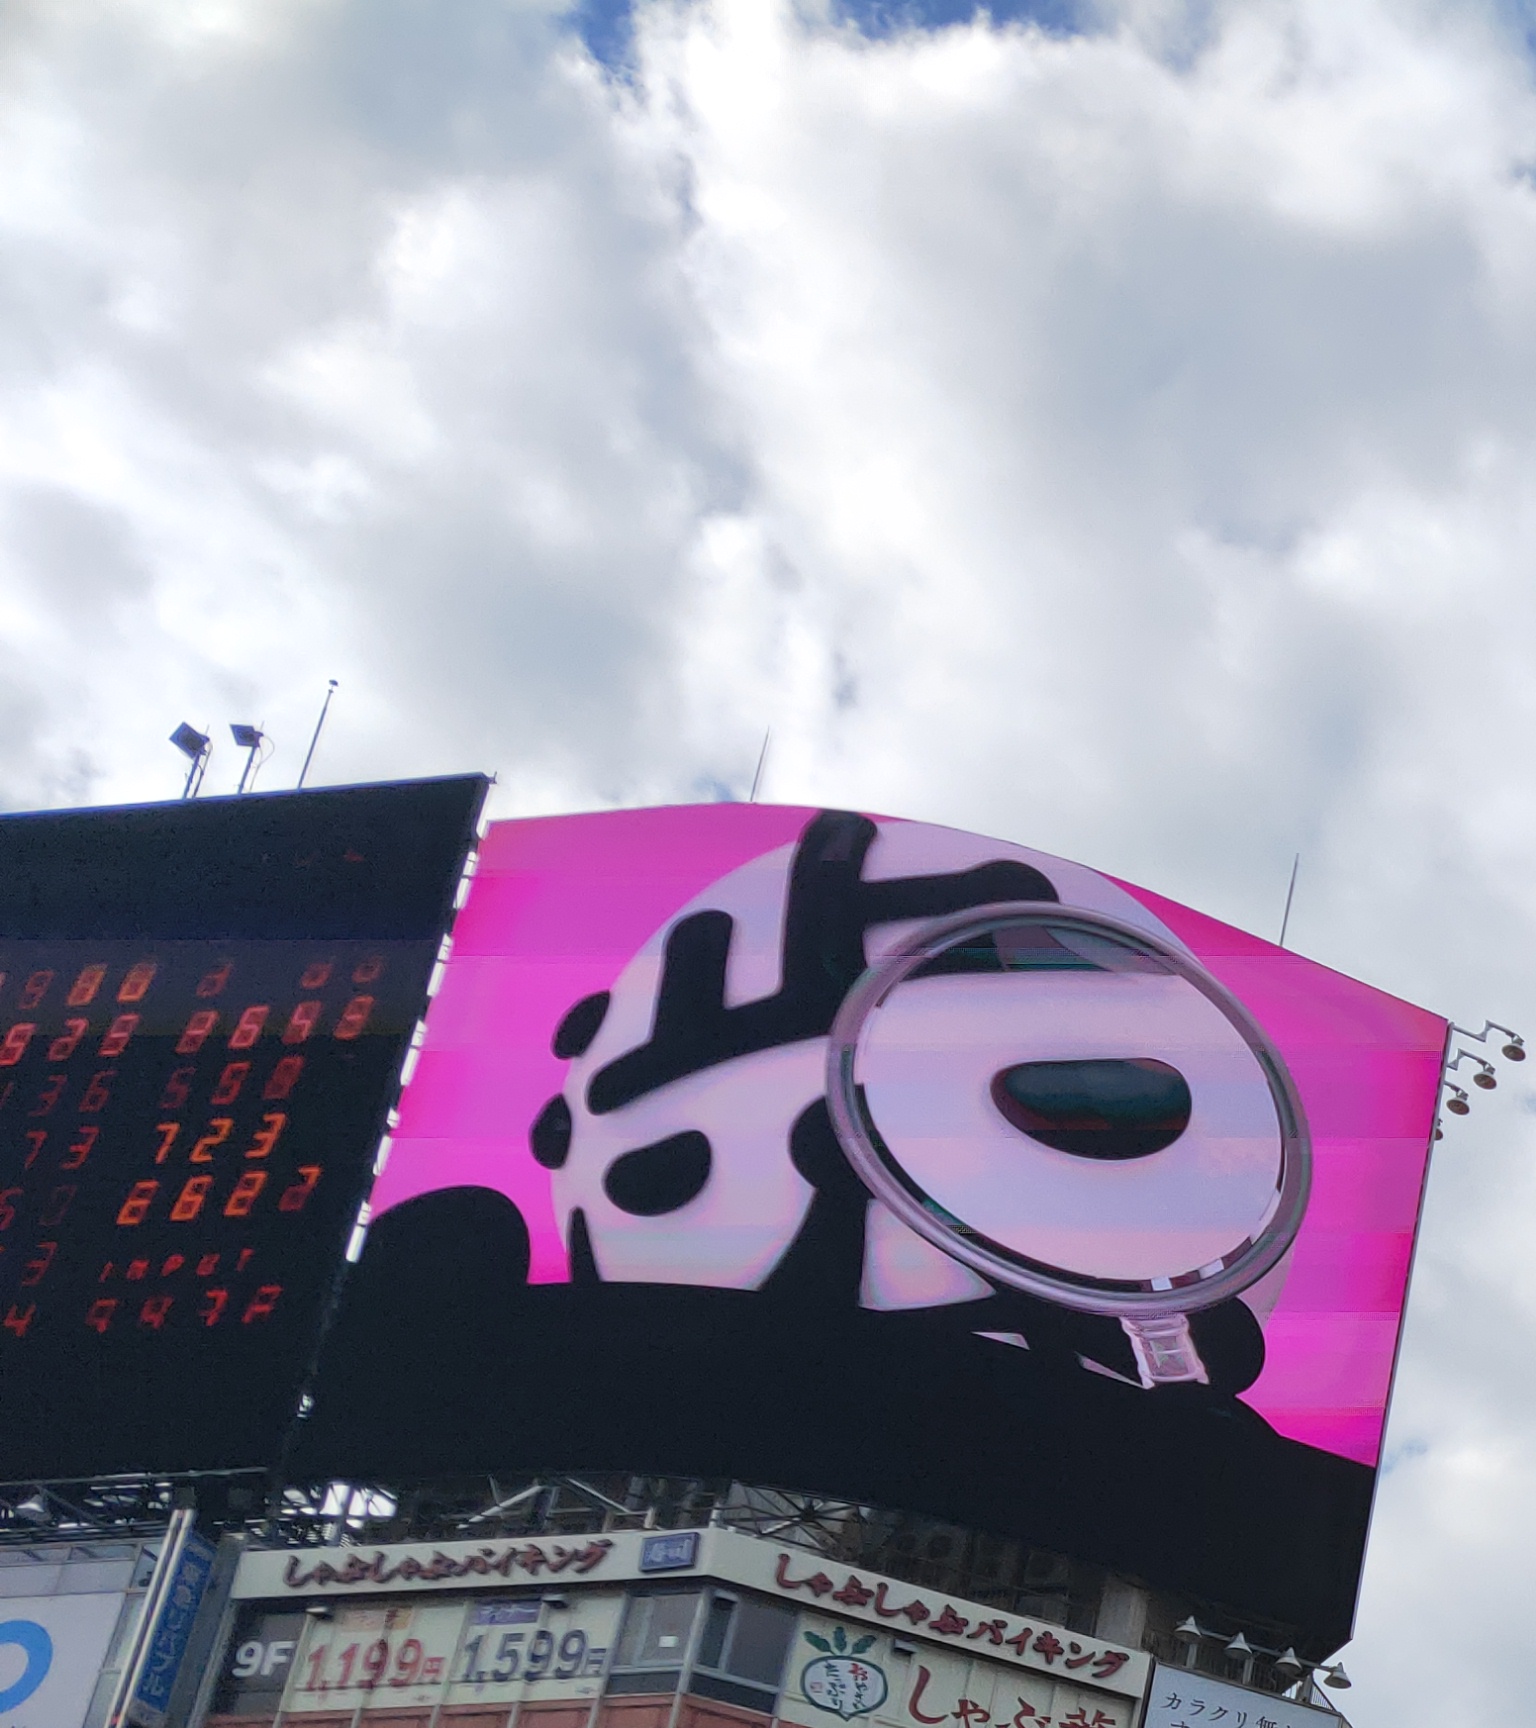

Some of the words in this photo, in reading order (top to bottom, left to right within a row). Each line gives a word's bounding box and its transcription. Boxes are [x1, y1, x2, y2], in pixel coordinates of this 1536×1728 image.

[775, 1552, 1130, 1679] しゃぶしゃぶバイキング
[231, 1639, 297, 1678] 9F
